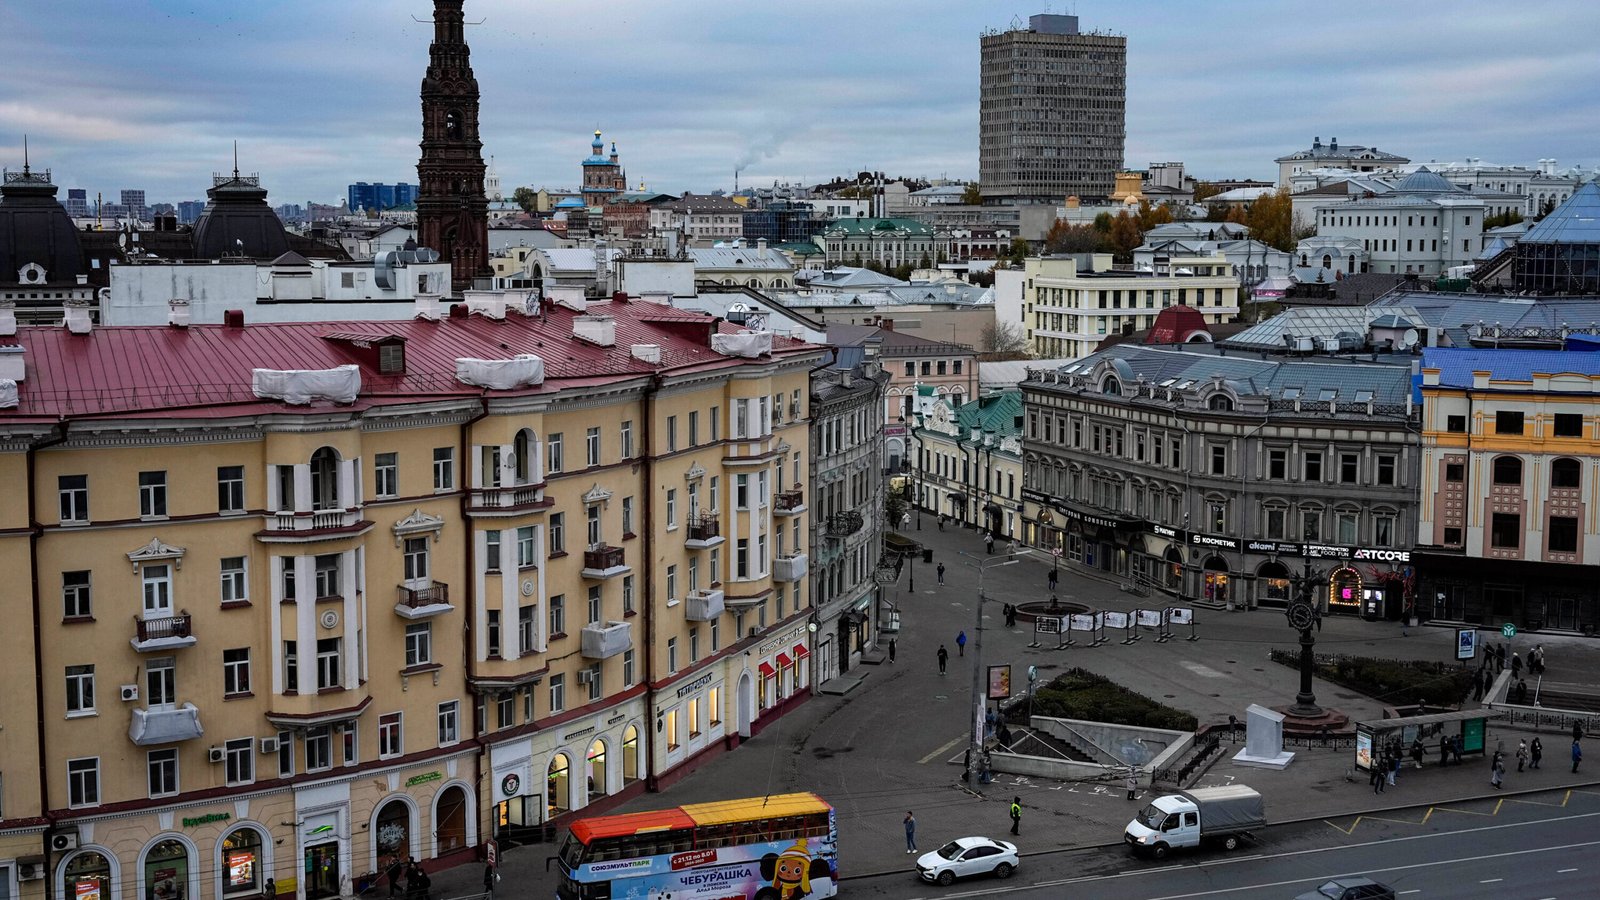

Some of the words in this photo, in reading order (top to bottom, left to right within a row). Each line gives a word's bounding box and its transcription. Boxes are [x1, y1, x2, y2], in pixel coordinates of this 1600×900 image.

[1202, 536, 1236, 548] КОСМЕТИК
[1248, 541, 1276, 551] akami
[1353, 548, 1410, 562] ARTCORE
[591, 860, 650, 872] СОЮЗМУЛЬТПАРК
[680, 868, 753, 886] ЧЕБУРАШКА
